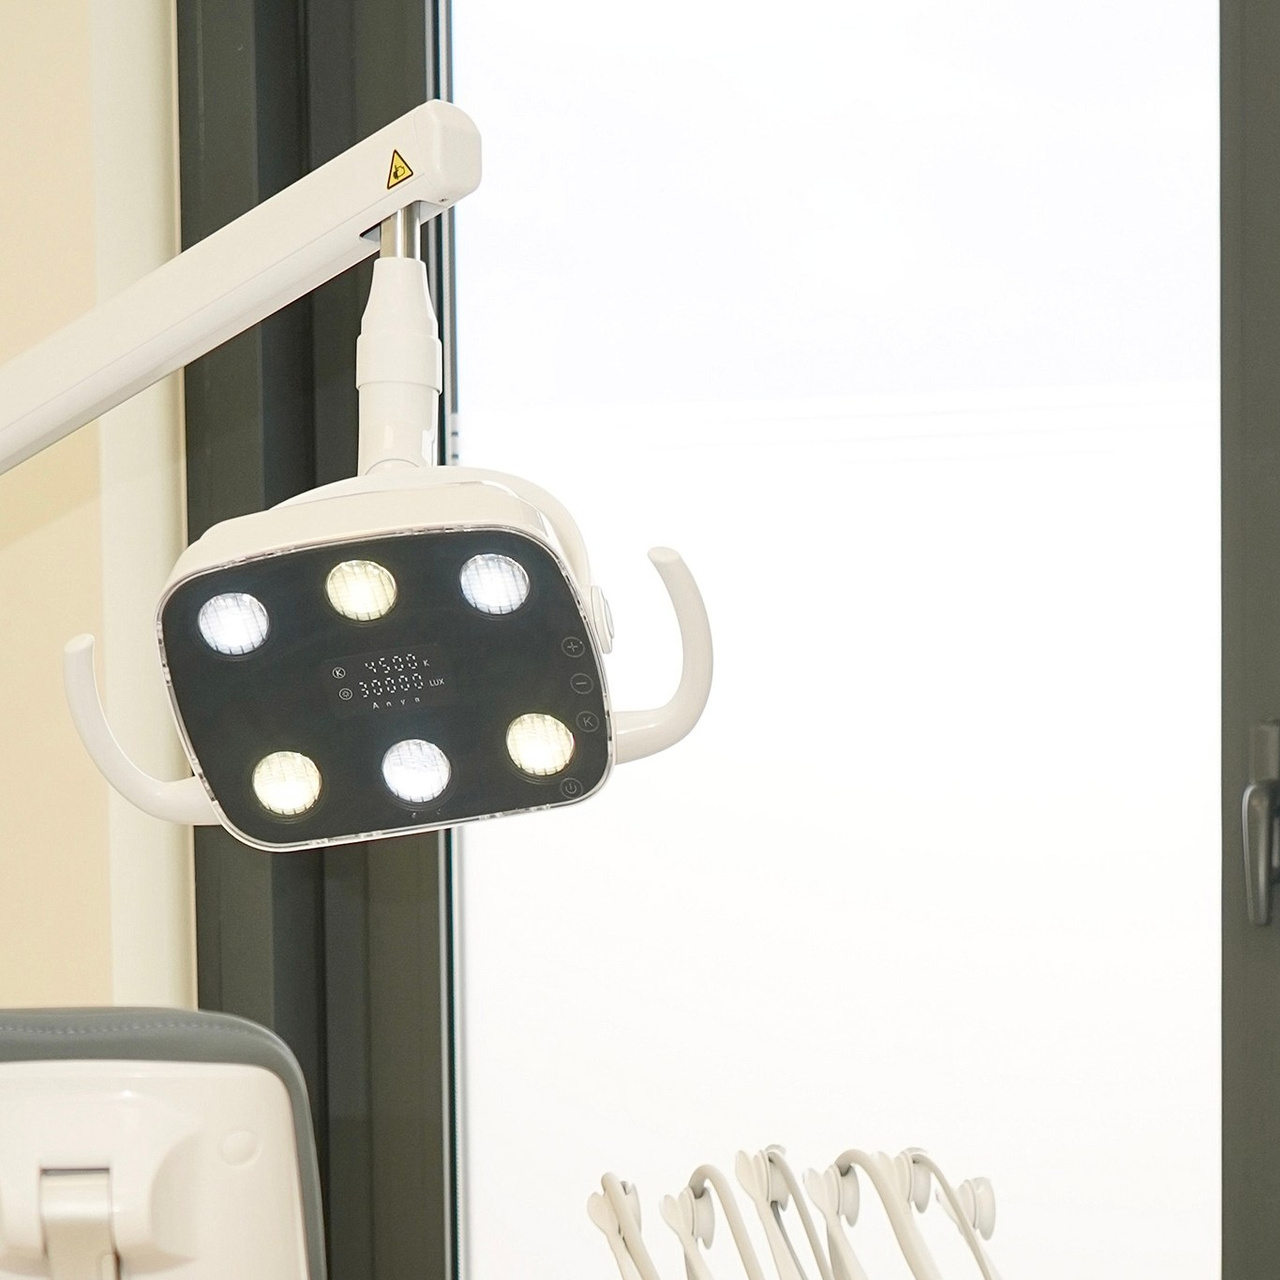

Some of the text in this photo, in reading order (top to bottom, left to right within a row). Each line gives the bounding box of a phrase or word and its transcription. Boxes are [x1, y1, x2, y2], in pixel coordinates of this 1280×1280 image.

[365, 653, 418, 674] 4500
[422, 659, 431, 667] K
[359, 673, 446, 698] 30000 LUX
